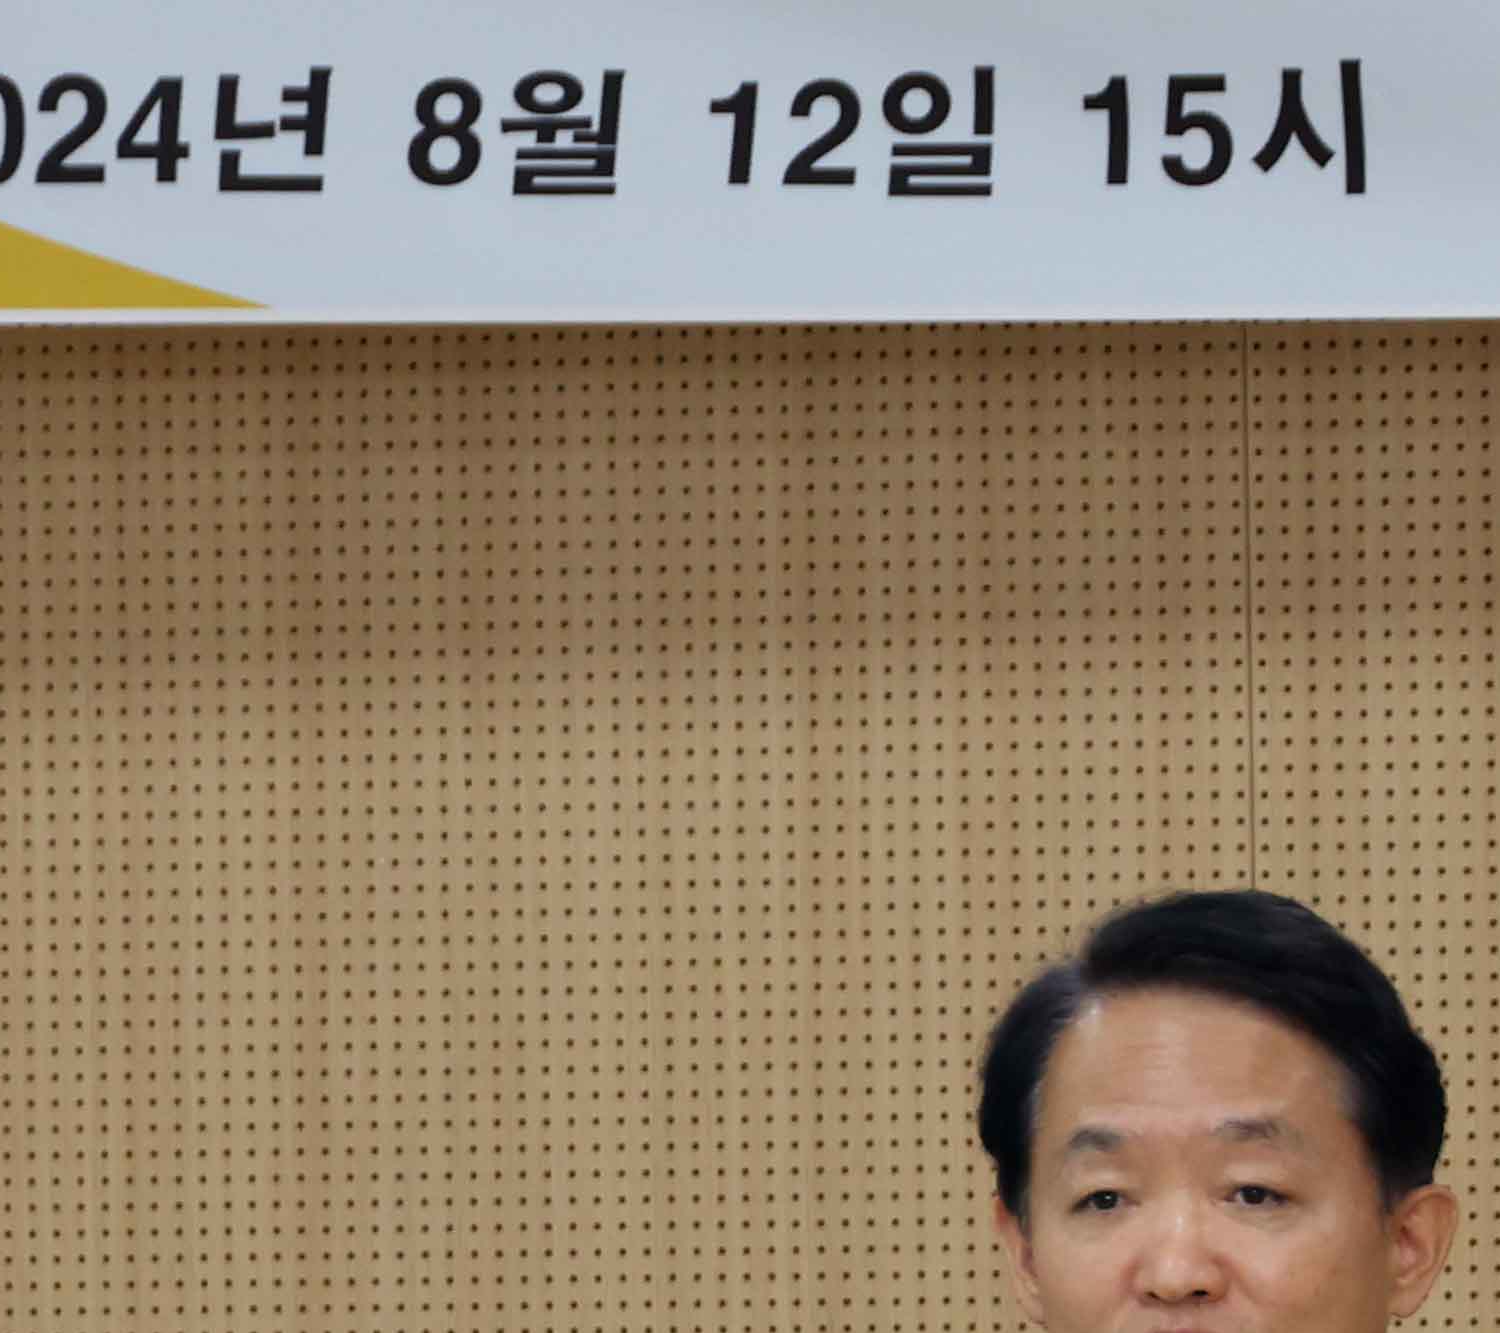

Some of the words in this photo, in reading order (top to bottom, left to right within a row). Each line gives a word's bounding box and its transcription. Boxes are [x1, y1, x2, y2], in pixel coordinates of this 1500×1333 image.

[406, 70, 626, 196] 8월
[709, 66, 996, 198] 12일
[1082, 59, 1368, 196] 15시
